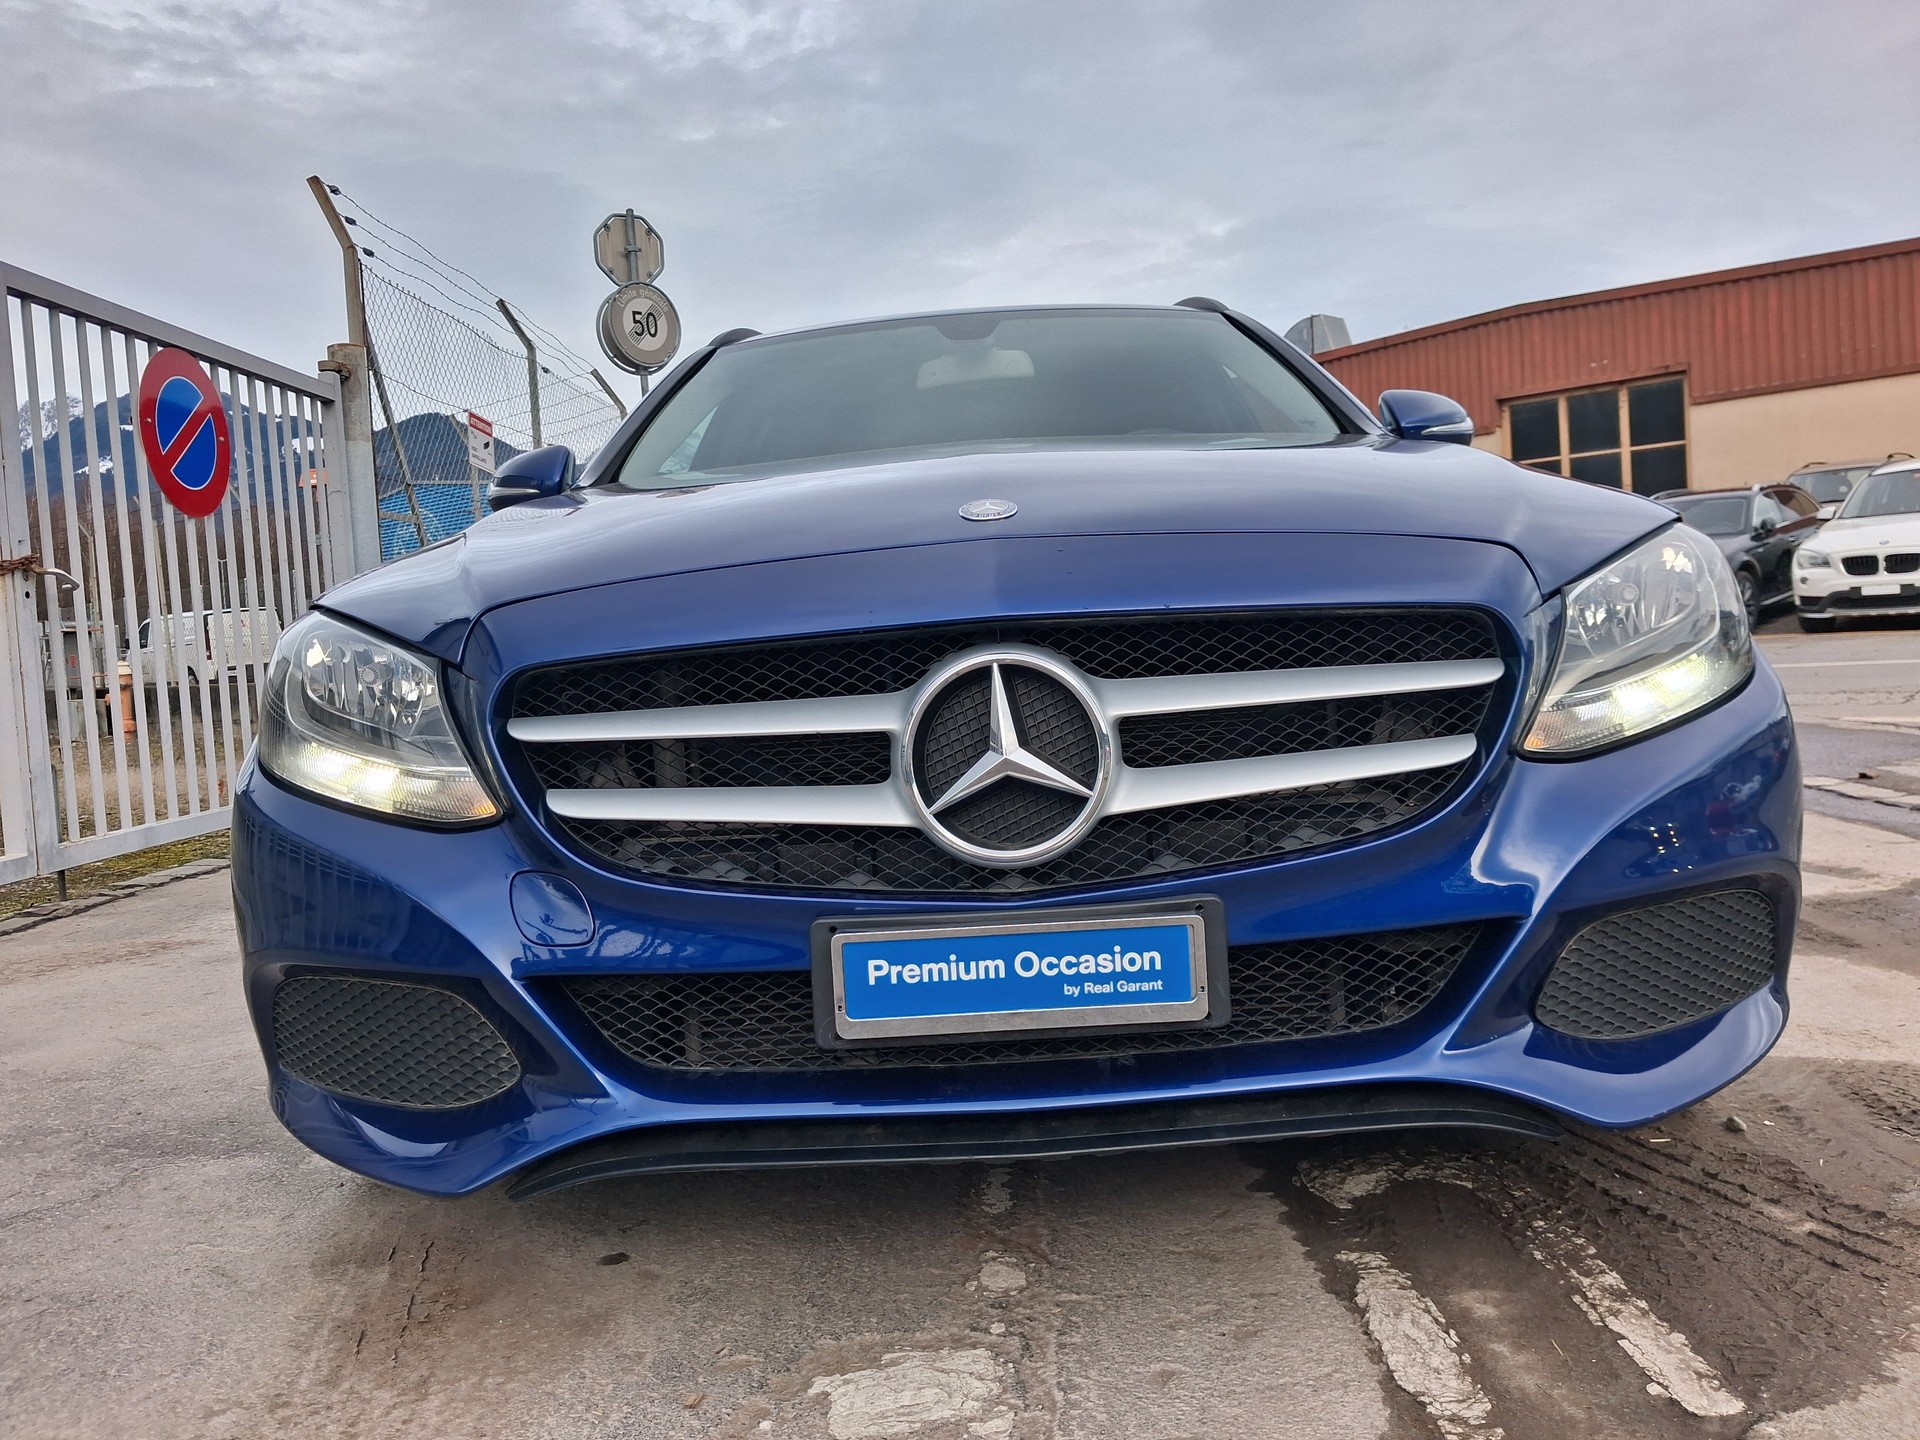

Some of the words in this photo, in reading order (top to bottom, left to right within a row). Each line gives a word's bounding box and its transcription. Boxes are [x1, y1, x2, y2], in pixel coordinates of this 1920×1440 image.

[618, 290, 637, 307] Limite
[640, 288, 669, 312] générale
[631, 310, 658, 338] 50
[867, 953, 1006, 986] Premium
[1014, 945, 1162, 978] Occasion
[1063, 983, 1081, 997] by
[1084, 980, 1114, 994] Real
[1117, 979, 1164, 993] Garant
